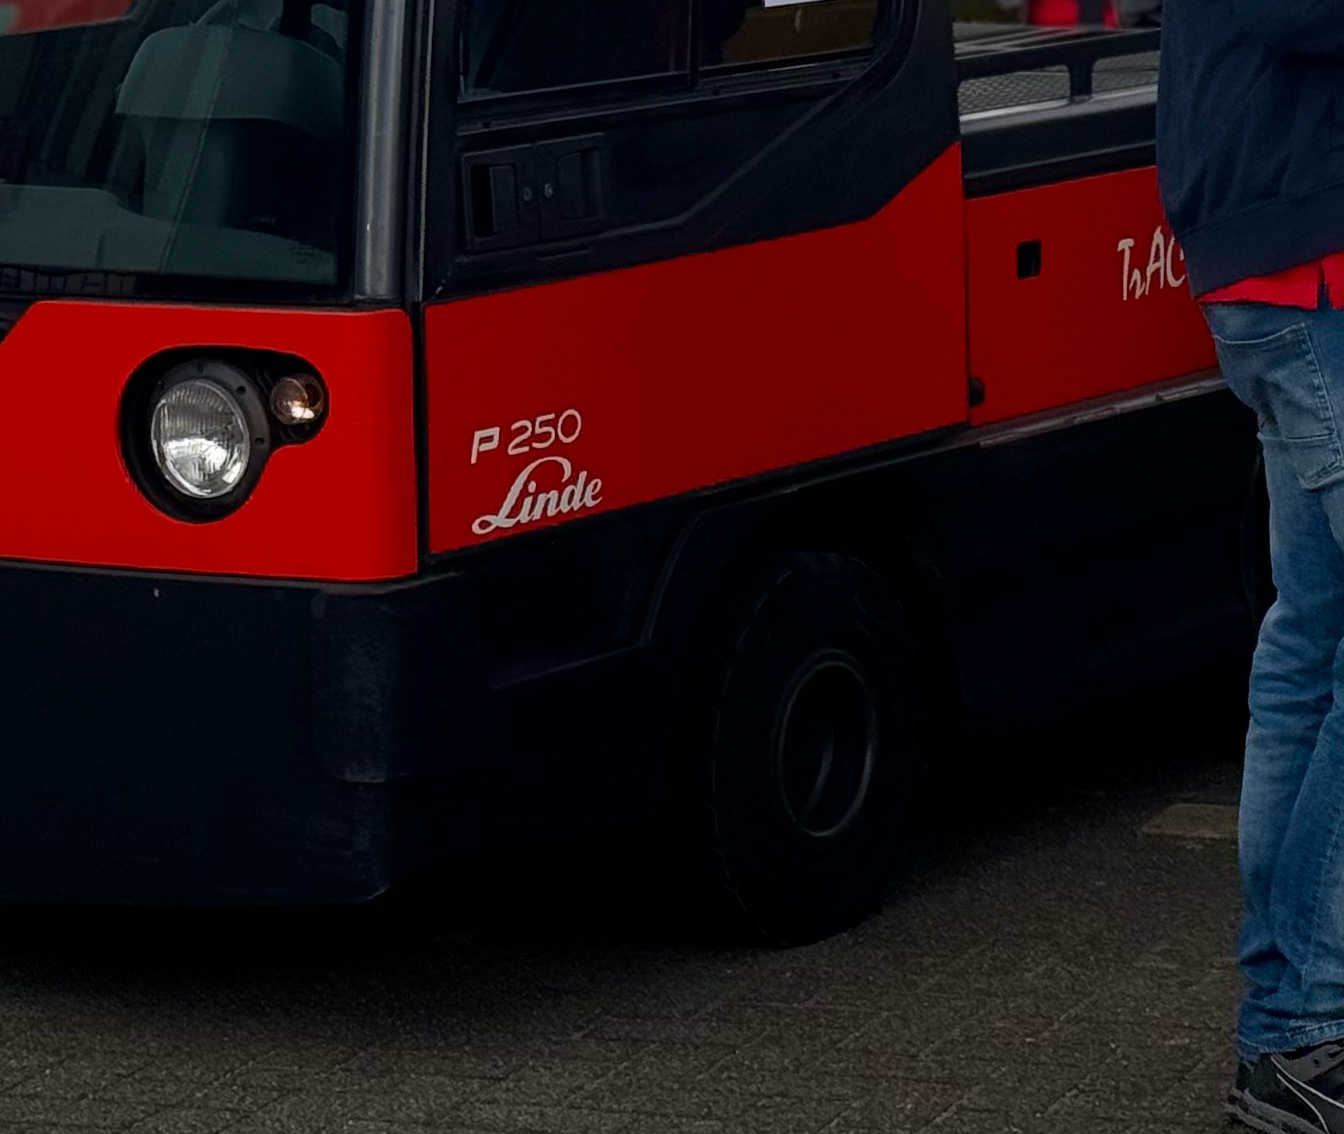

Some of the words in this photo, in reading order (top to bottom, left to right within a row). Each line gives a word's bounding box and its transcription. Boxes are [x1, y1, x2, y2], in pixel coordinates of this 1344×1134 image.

[470, 426, 501, 465] P
[507, 408, 582, 456] 250
[471, 456, 603, 535] Linde
